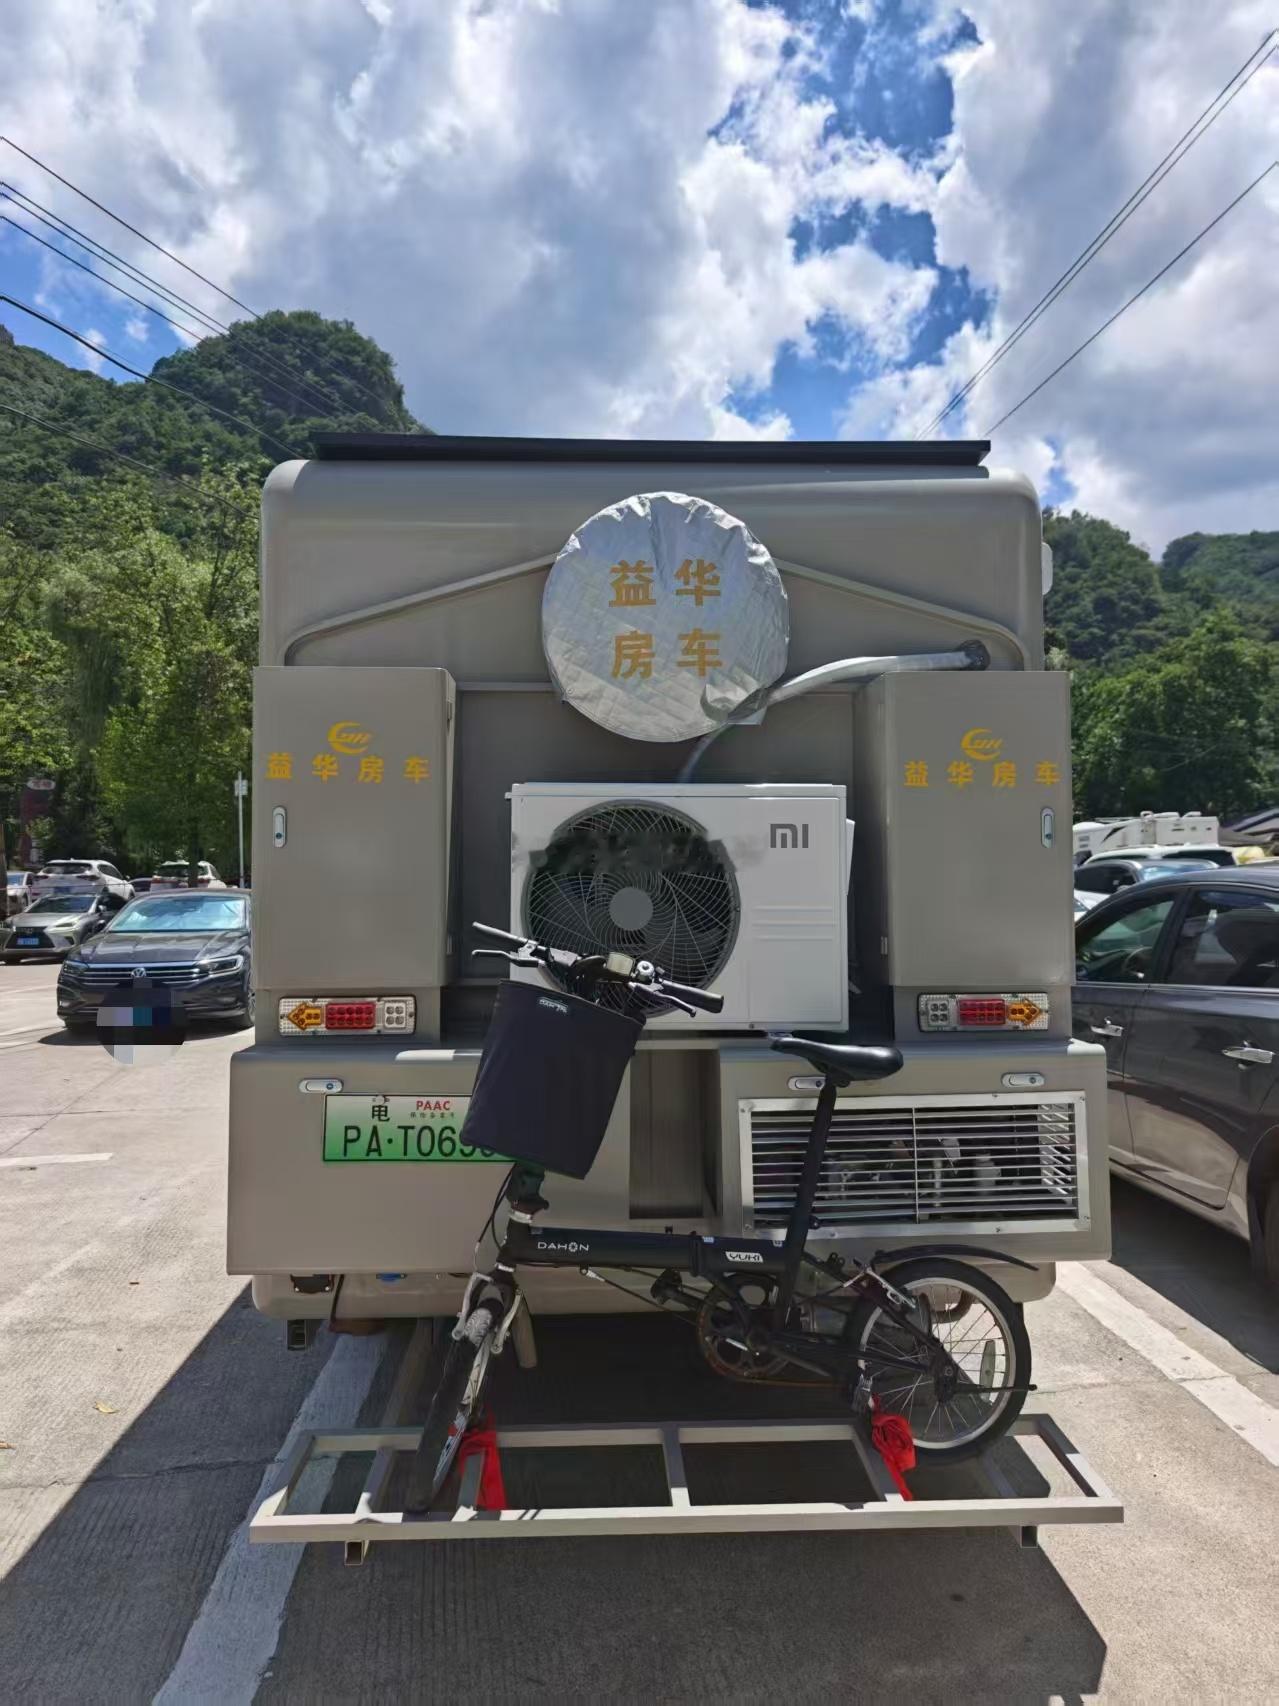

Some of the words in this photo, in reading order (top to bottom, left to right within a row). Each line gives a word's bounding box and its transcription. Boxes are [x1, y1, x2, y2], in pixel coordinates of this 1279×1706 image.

[608, 559, 721, 608] 益华
[610, 628, 723, 679] 房车
[265, 752, 431, 785] 益华房车
[903, 761, 1062, 789] 益华房车
[371, 1104, 391, 1122] 电
[416, 1100, 451, 1111] PAAC
[537, 1241, 590, 1251] DAHON
